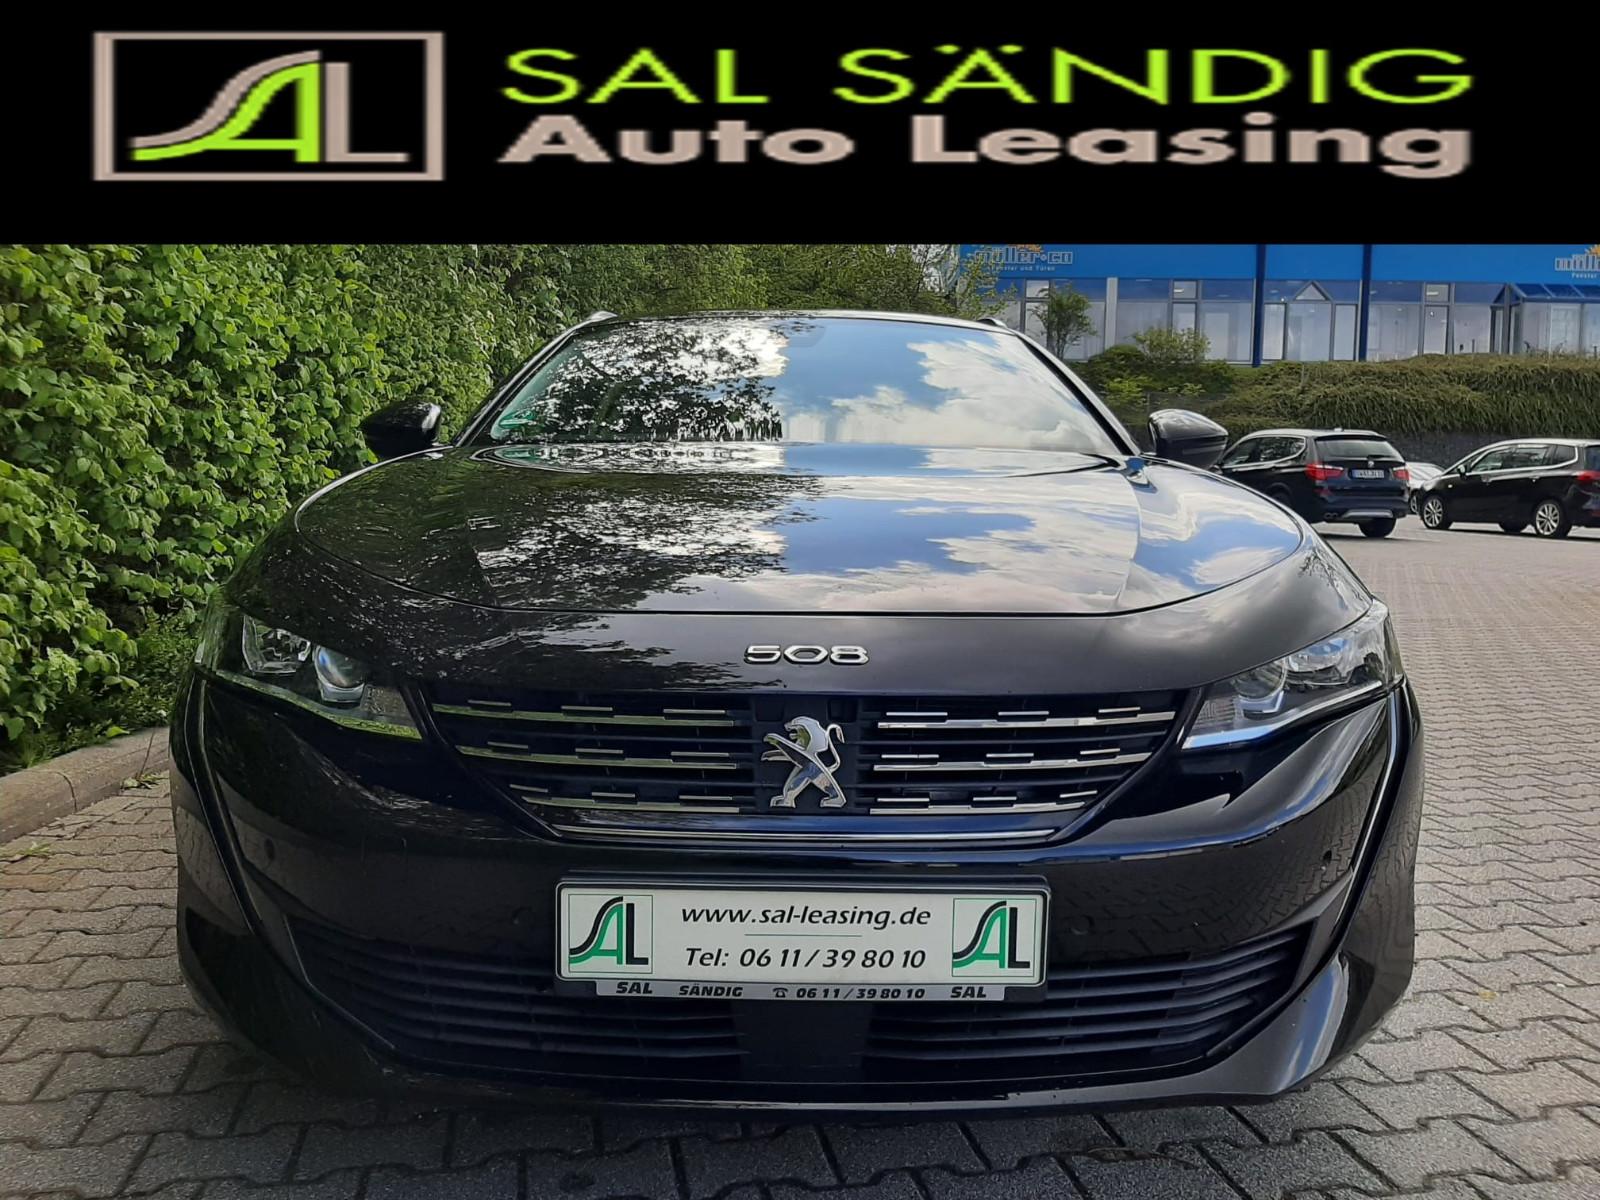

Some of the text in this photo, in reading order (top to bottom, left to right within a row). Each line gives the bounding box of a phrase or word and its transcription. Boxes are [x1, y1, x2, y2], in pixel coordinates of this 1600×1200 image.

[744, 645, 869, 664] 508
[681, 905, 932, 930] www.sal-leasing.de
[686, 948, 729, 967] Tel:
[616, 982, 653, 995] SAL
[679, 983, 743, 997] SÄNDIG
[950, 986, 987, 998] SAL
